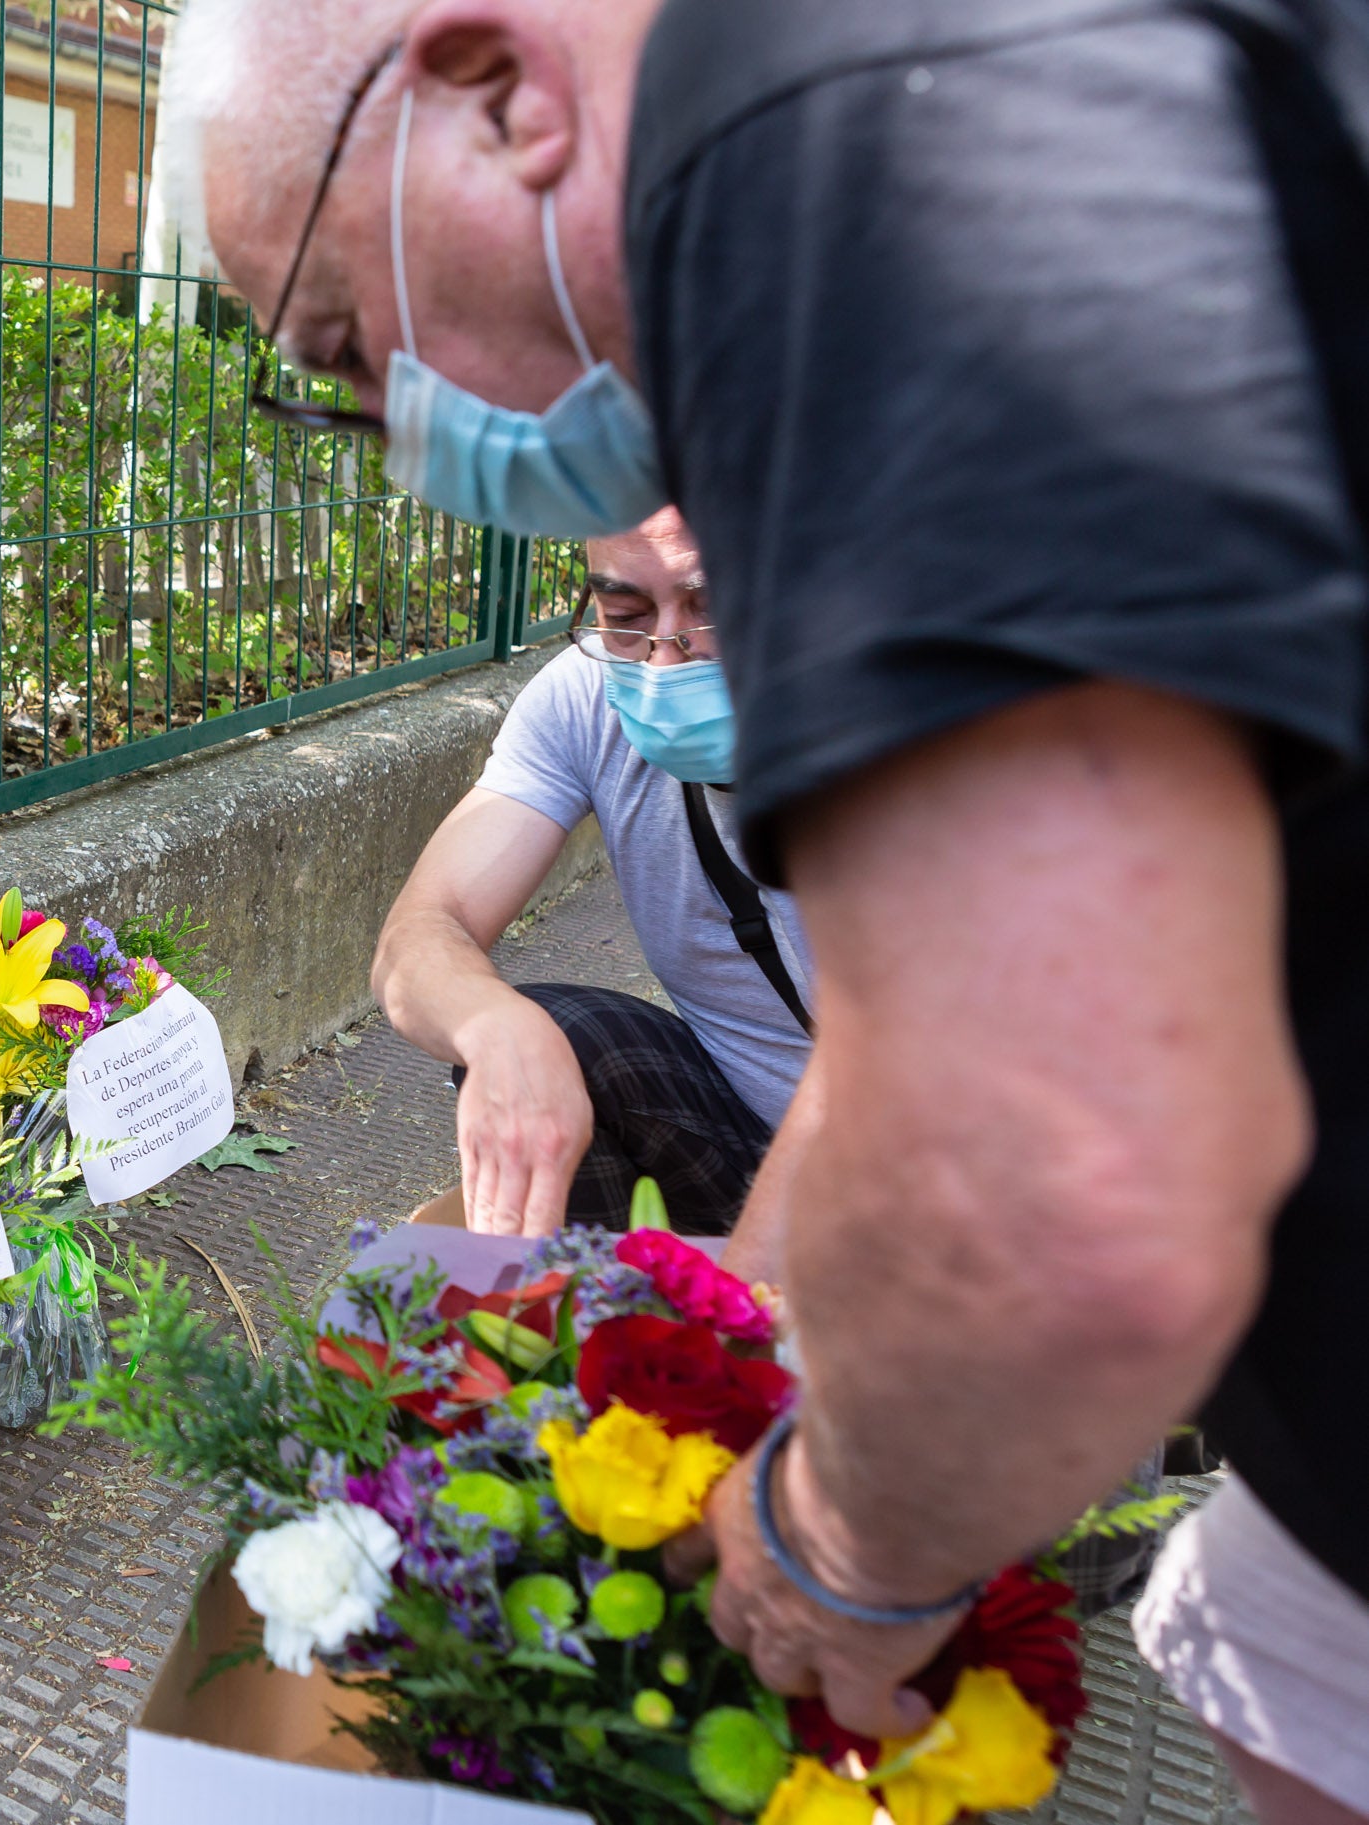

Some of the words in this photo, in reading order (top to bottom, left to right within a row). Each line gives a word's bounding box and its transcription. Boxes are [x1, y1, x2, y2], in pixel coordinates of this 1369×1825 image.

[82, 1070, 102, 1085] La
[103, 1037, 163, 1075] Federación
[162, 1007, 197, 1042] Saharaui
[101, 1086, 116, 1102] de
[118, 1057, 172, 1093] Deportes
[172, 1042, 193, 1064] apoya
[192, 1036, 199, 1050] y
[116, 1091, 155, 1119] espera
[157, 1079, 179, 1097] una
[180, 1059, 204, 1088] pronta
[128, 1089, 200, 1137] recuperación
[199, 1079, 208, 1095] al
[109, 1130, 174, 1171] Presidente
[175, 1104, 212, 1136] Brahim
